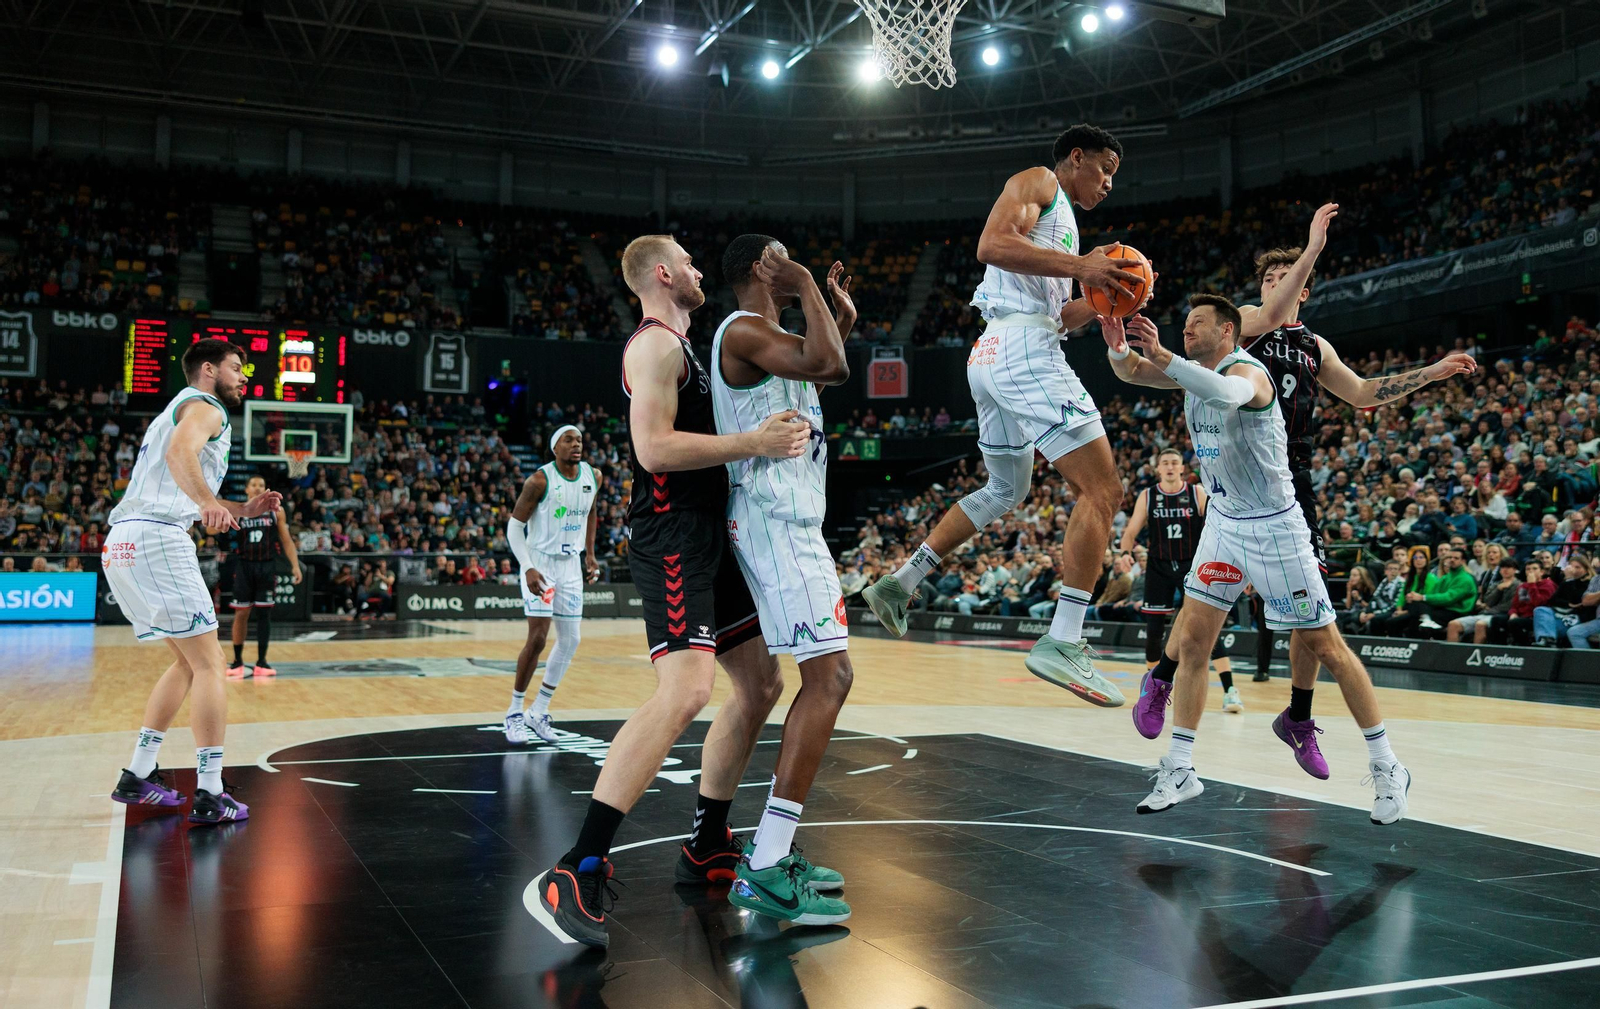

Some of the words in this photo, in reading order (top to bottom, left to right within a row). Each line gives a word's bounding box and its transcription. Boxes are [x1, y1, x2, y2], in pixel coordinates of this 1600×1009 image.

[53, 310, 98, 328] bbk
[2, 330, 20, 349] 14
[353, 329, 394, 345] bbk
[440, 352, 455, 370] 15
[876, 364, 899, 382] 25
[1281, 373, 1298, 399] 9
[842, 441, 856, 456] A
[1210, 473, 1228, 498] 4
[1152, 506, 1194, 519] surne
[248, 529, 264, 543] 19
[1166, 523, 1183, 539] 12
[120, 552, 136, 560] SOL
[424, 597, 465, 612] IMQ
[490, 596, 526, 608] Petro
[972, 621, 1003, 631] NISSAN
[1360, 645, 1372, 656] EL
[1373, 645, 1413, 659] CORREO
[1484, 653, 1524, 668] agaleus
